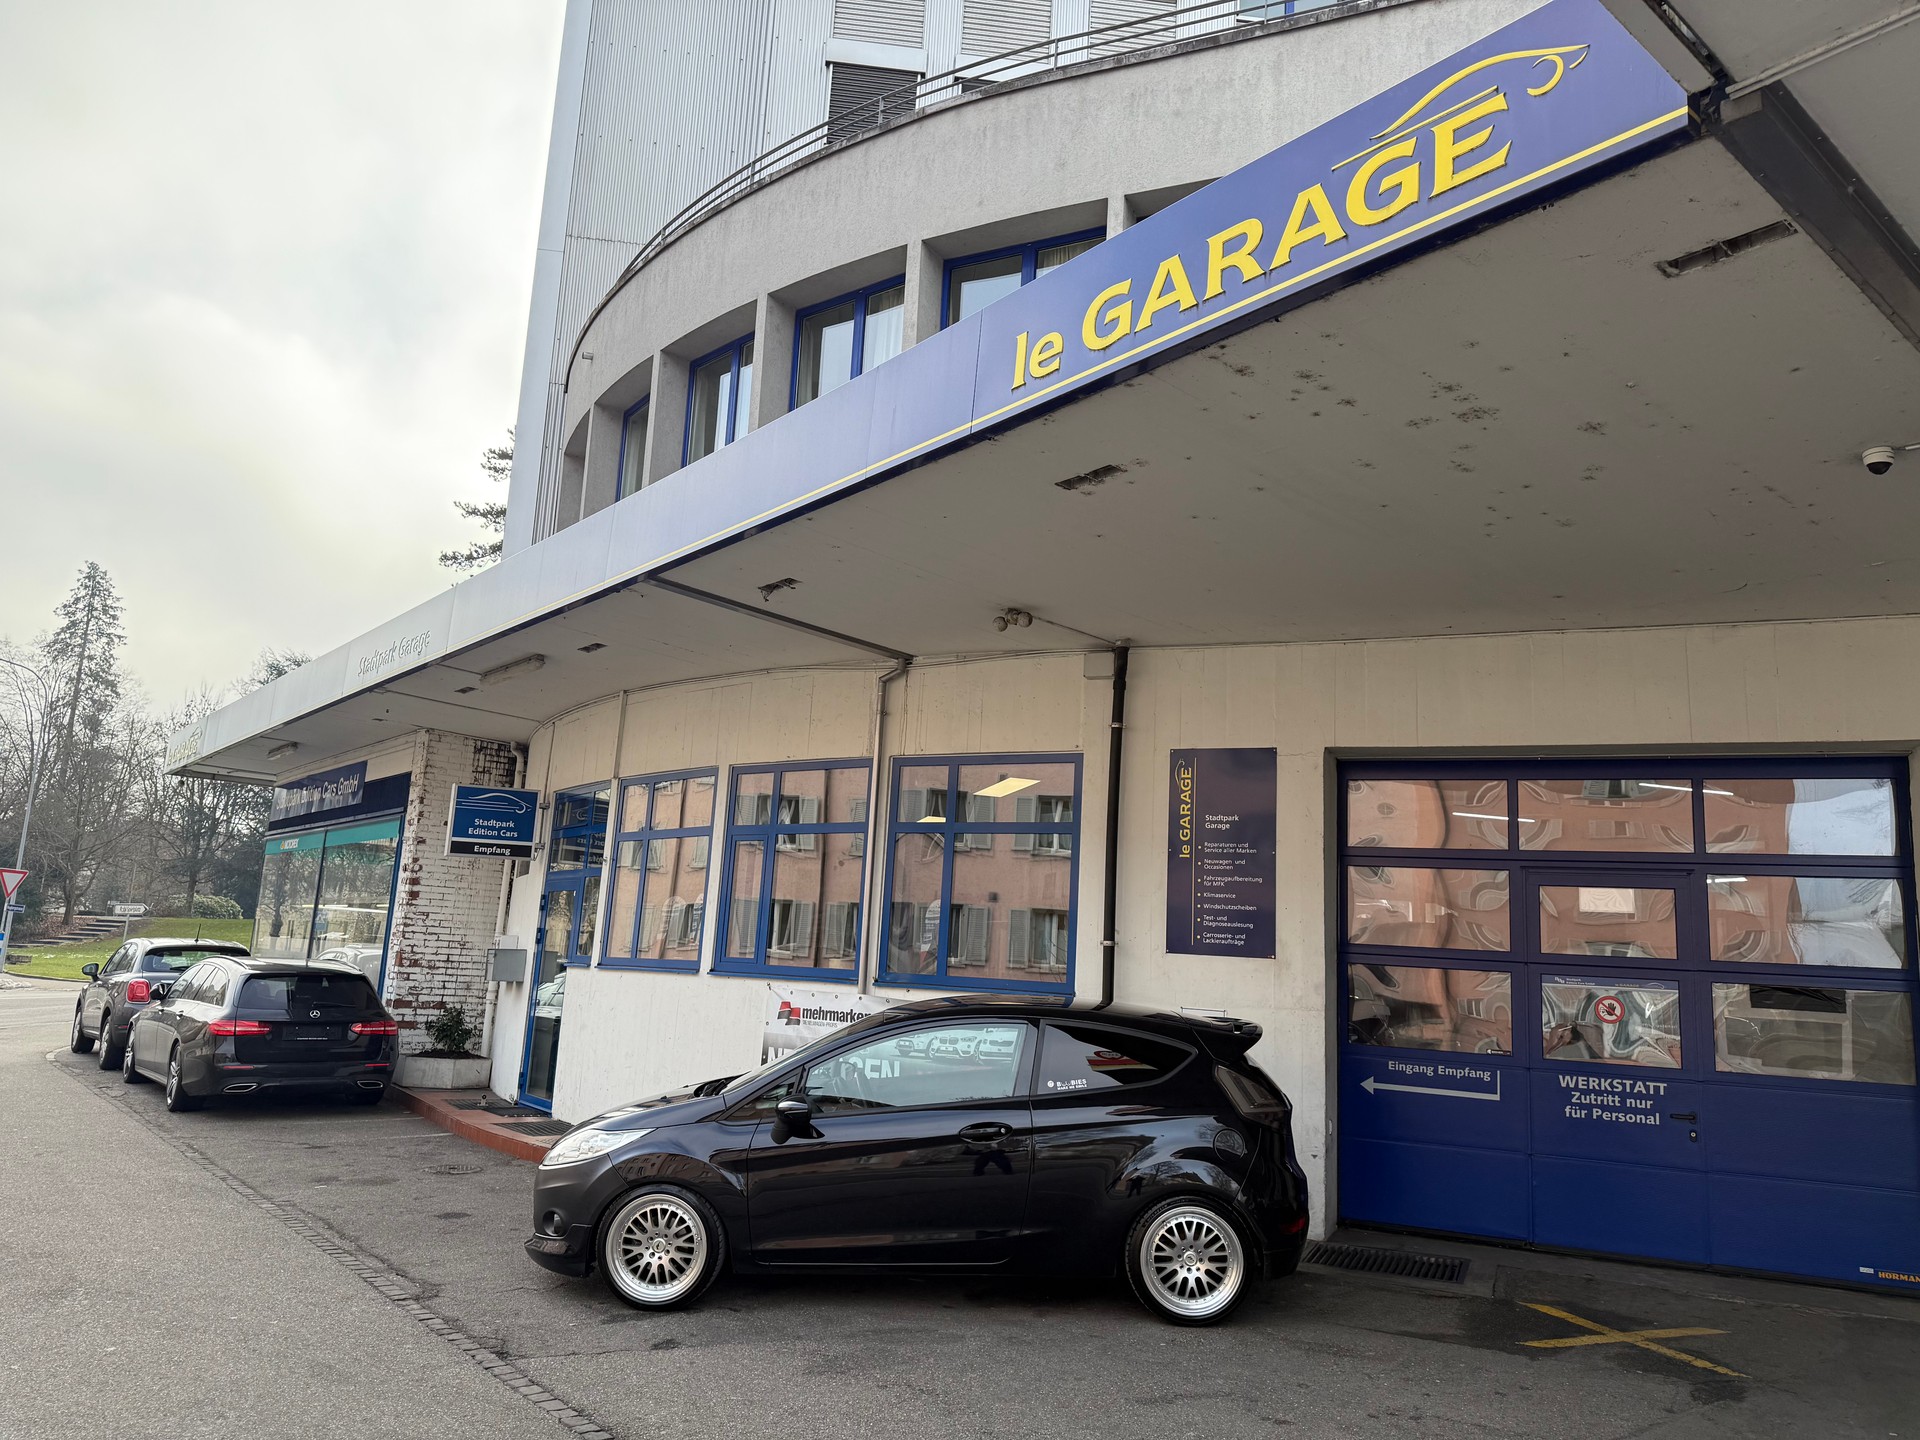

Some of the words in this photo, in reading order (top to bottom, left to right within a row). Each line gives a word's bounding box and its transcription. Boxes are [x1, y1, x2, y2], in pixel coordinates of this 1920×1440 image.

[1011, 331, 1063, 391] le
[1081, 92, 1512, 352] GARAGE
[358, 640, 398, 677] Stadtpark
[399, 629, 431, 659] Garage
[322, 780, 338, 799] Cars
[337, 773, 360, 796] GmbH
[1179, 767, 1192, 841] GARAGE
[474, 818, 515, 828] Stadtpark
[1205, 814, 1240, 822] Stadtpark
[468, 827, 498, 836] Edition
[500, 829, 518, 837] Cars
[1205, 822, 1231, 831] Garage
[474, 845, 511, 856] Empfang
[1179, 844, 1191, 858] le
[1203, 875, 1263, 883] Fahrzeugaufbereitung
[1203, 903, 1257, 911] Windschutzscheiben
[1203, 920, 1254, 929] Diagnoseauslesung
[1202, 938, 1245, 946] Lackieraufträge
[1388, 1061, 1434, 1076] Eingang
[1437, 1065, 1491, 1081] Empfang
[1558, 1074, 1668, 1096] WERKSTATT
[1571, 1091, 1621, 1106] Zutritt
[1626, 1098, 1653, 1109] nur
[1564, 1105, 1588, 1118] für
[1592, 1108, 1660, 1125] Personal
